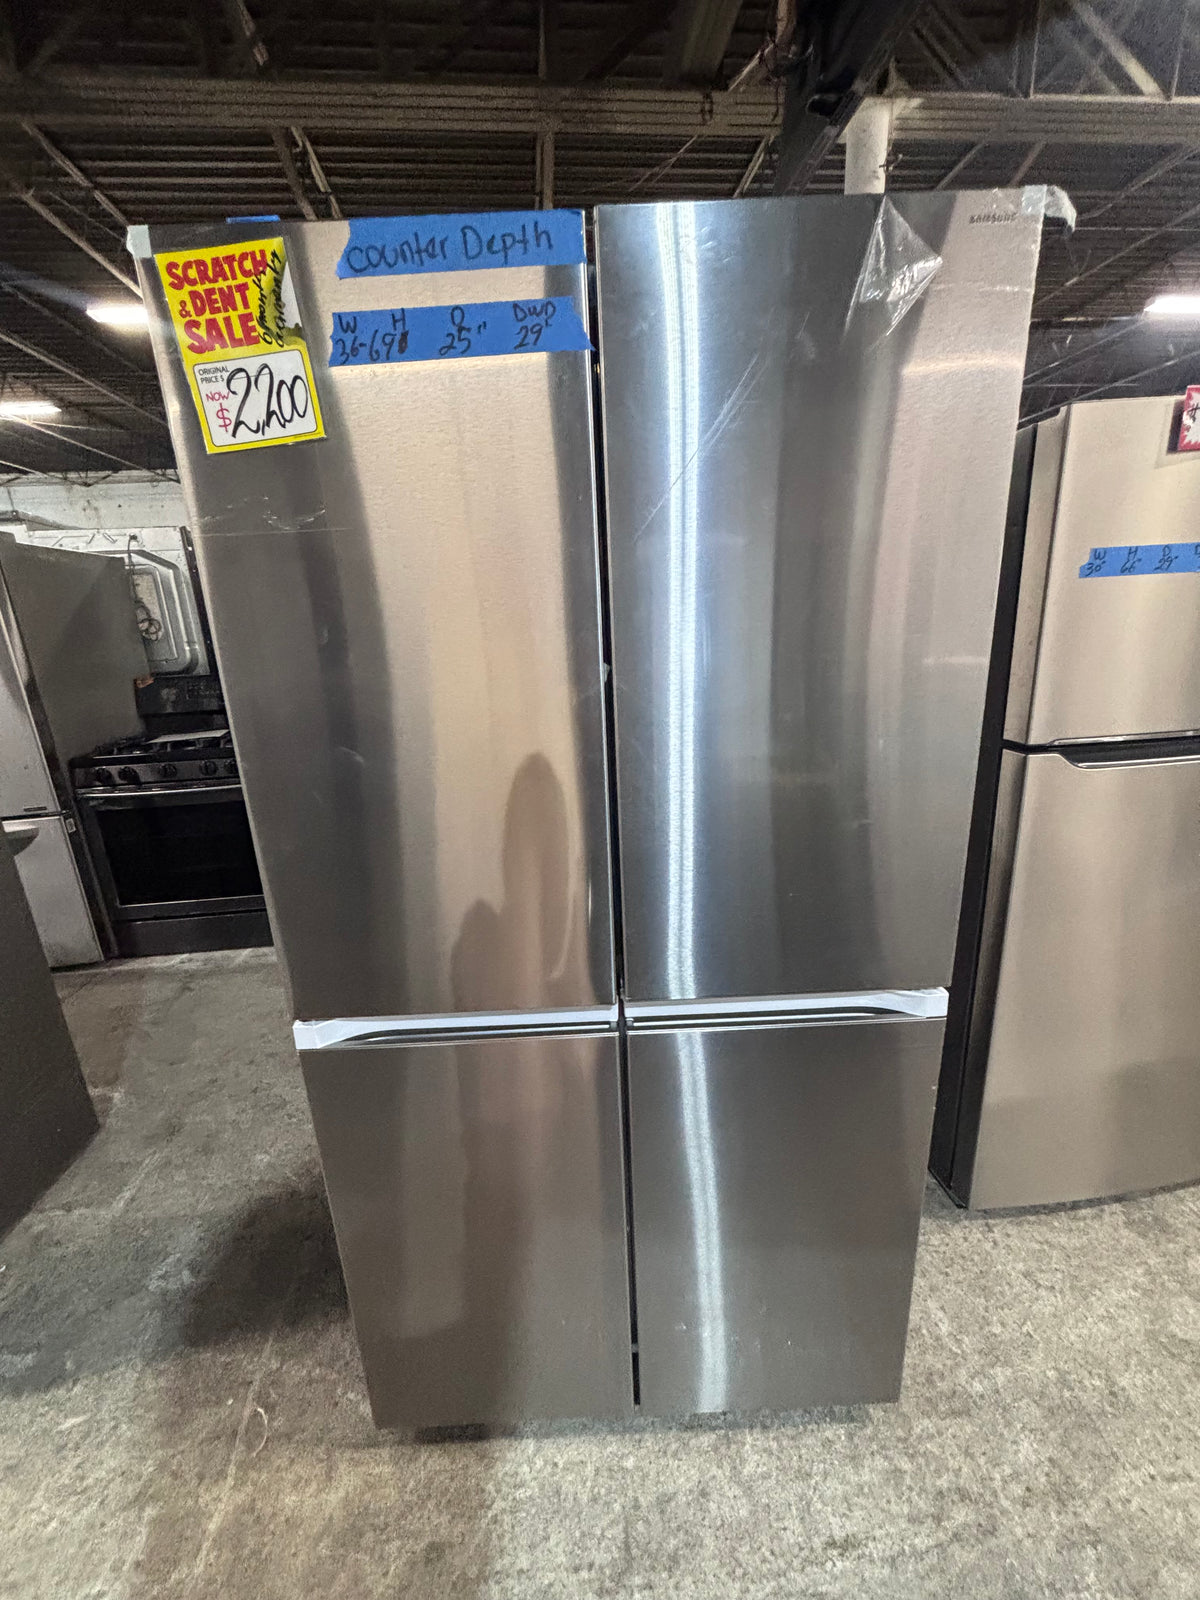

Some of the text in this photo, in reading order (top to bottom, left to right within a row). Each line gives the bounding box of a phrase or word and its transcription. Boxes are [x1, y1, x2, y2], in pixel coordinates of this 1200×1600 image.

[460, 220, 553, 264] Depth
[165, 249, 268, 290] SCRATCH
[179, 282, 250, 319] & DENT
[184, 312, 260, 355] SALE
[337, 314, 358, 334] W
[391, 307, 406, 331] H
[198, 365, 230, 376] ORIGINAL
[200, 376, 219, 384] PRICE
[205, 390, 230, 401] NOW
